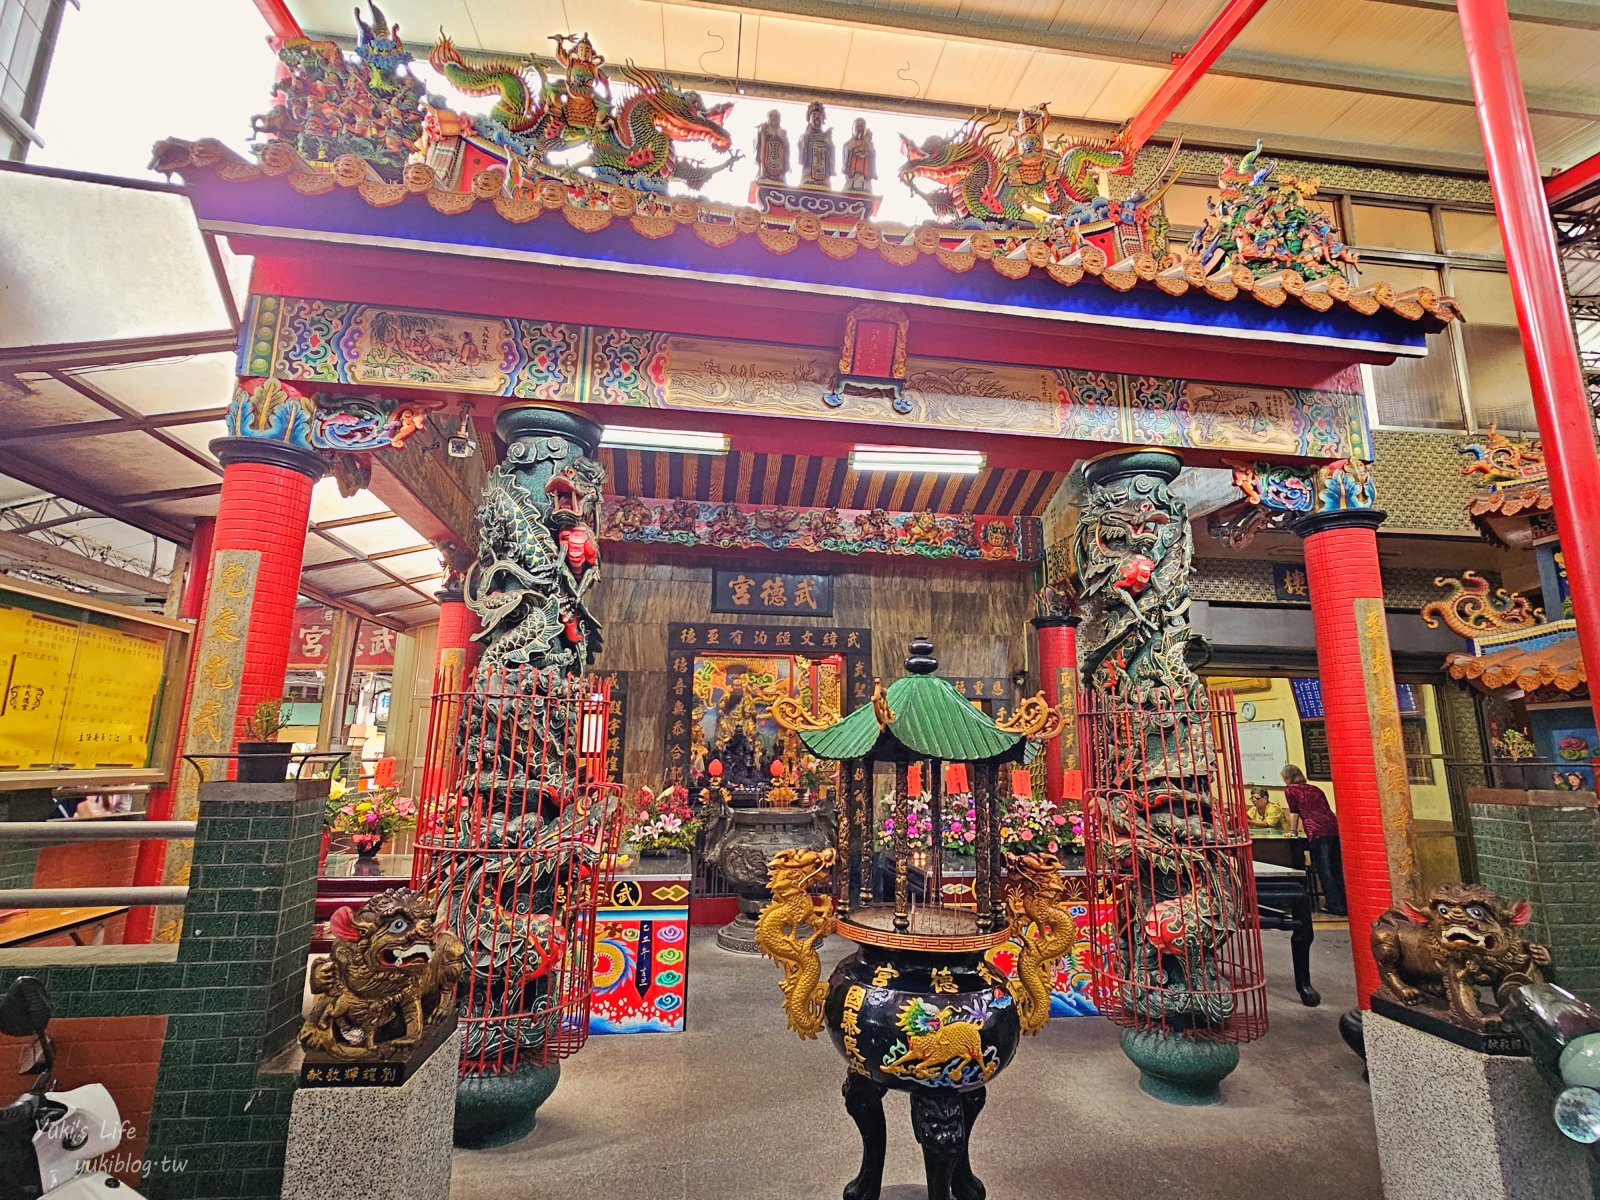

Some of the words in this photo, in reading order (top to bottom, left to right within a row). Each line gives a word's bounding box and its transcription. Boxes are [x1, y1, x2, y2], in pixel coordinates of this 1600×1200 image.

[727, 574, 818, 611] 武德宮
[616, 882, 636, 906] 武
[872, 960, 1003, 993] 武德宮
